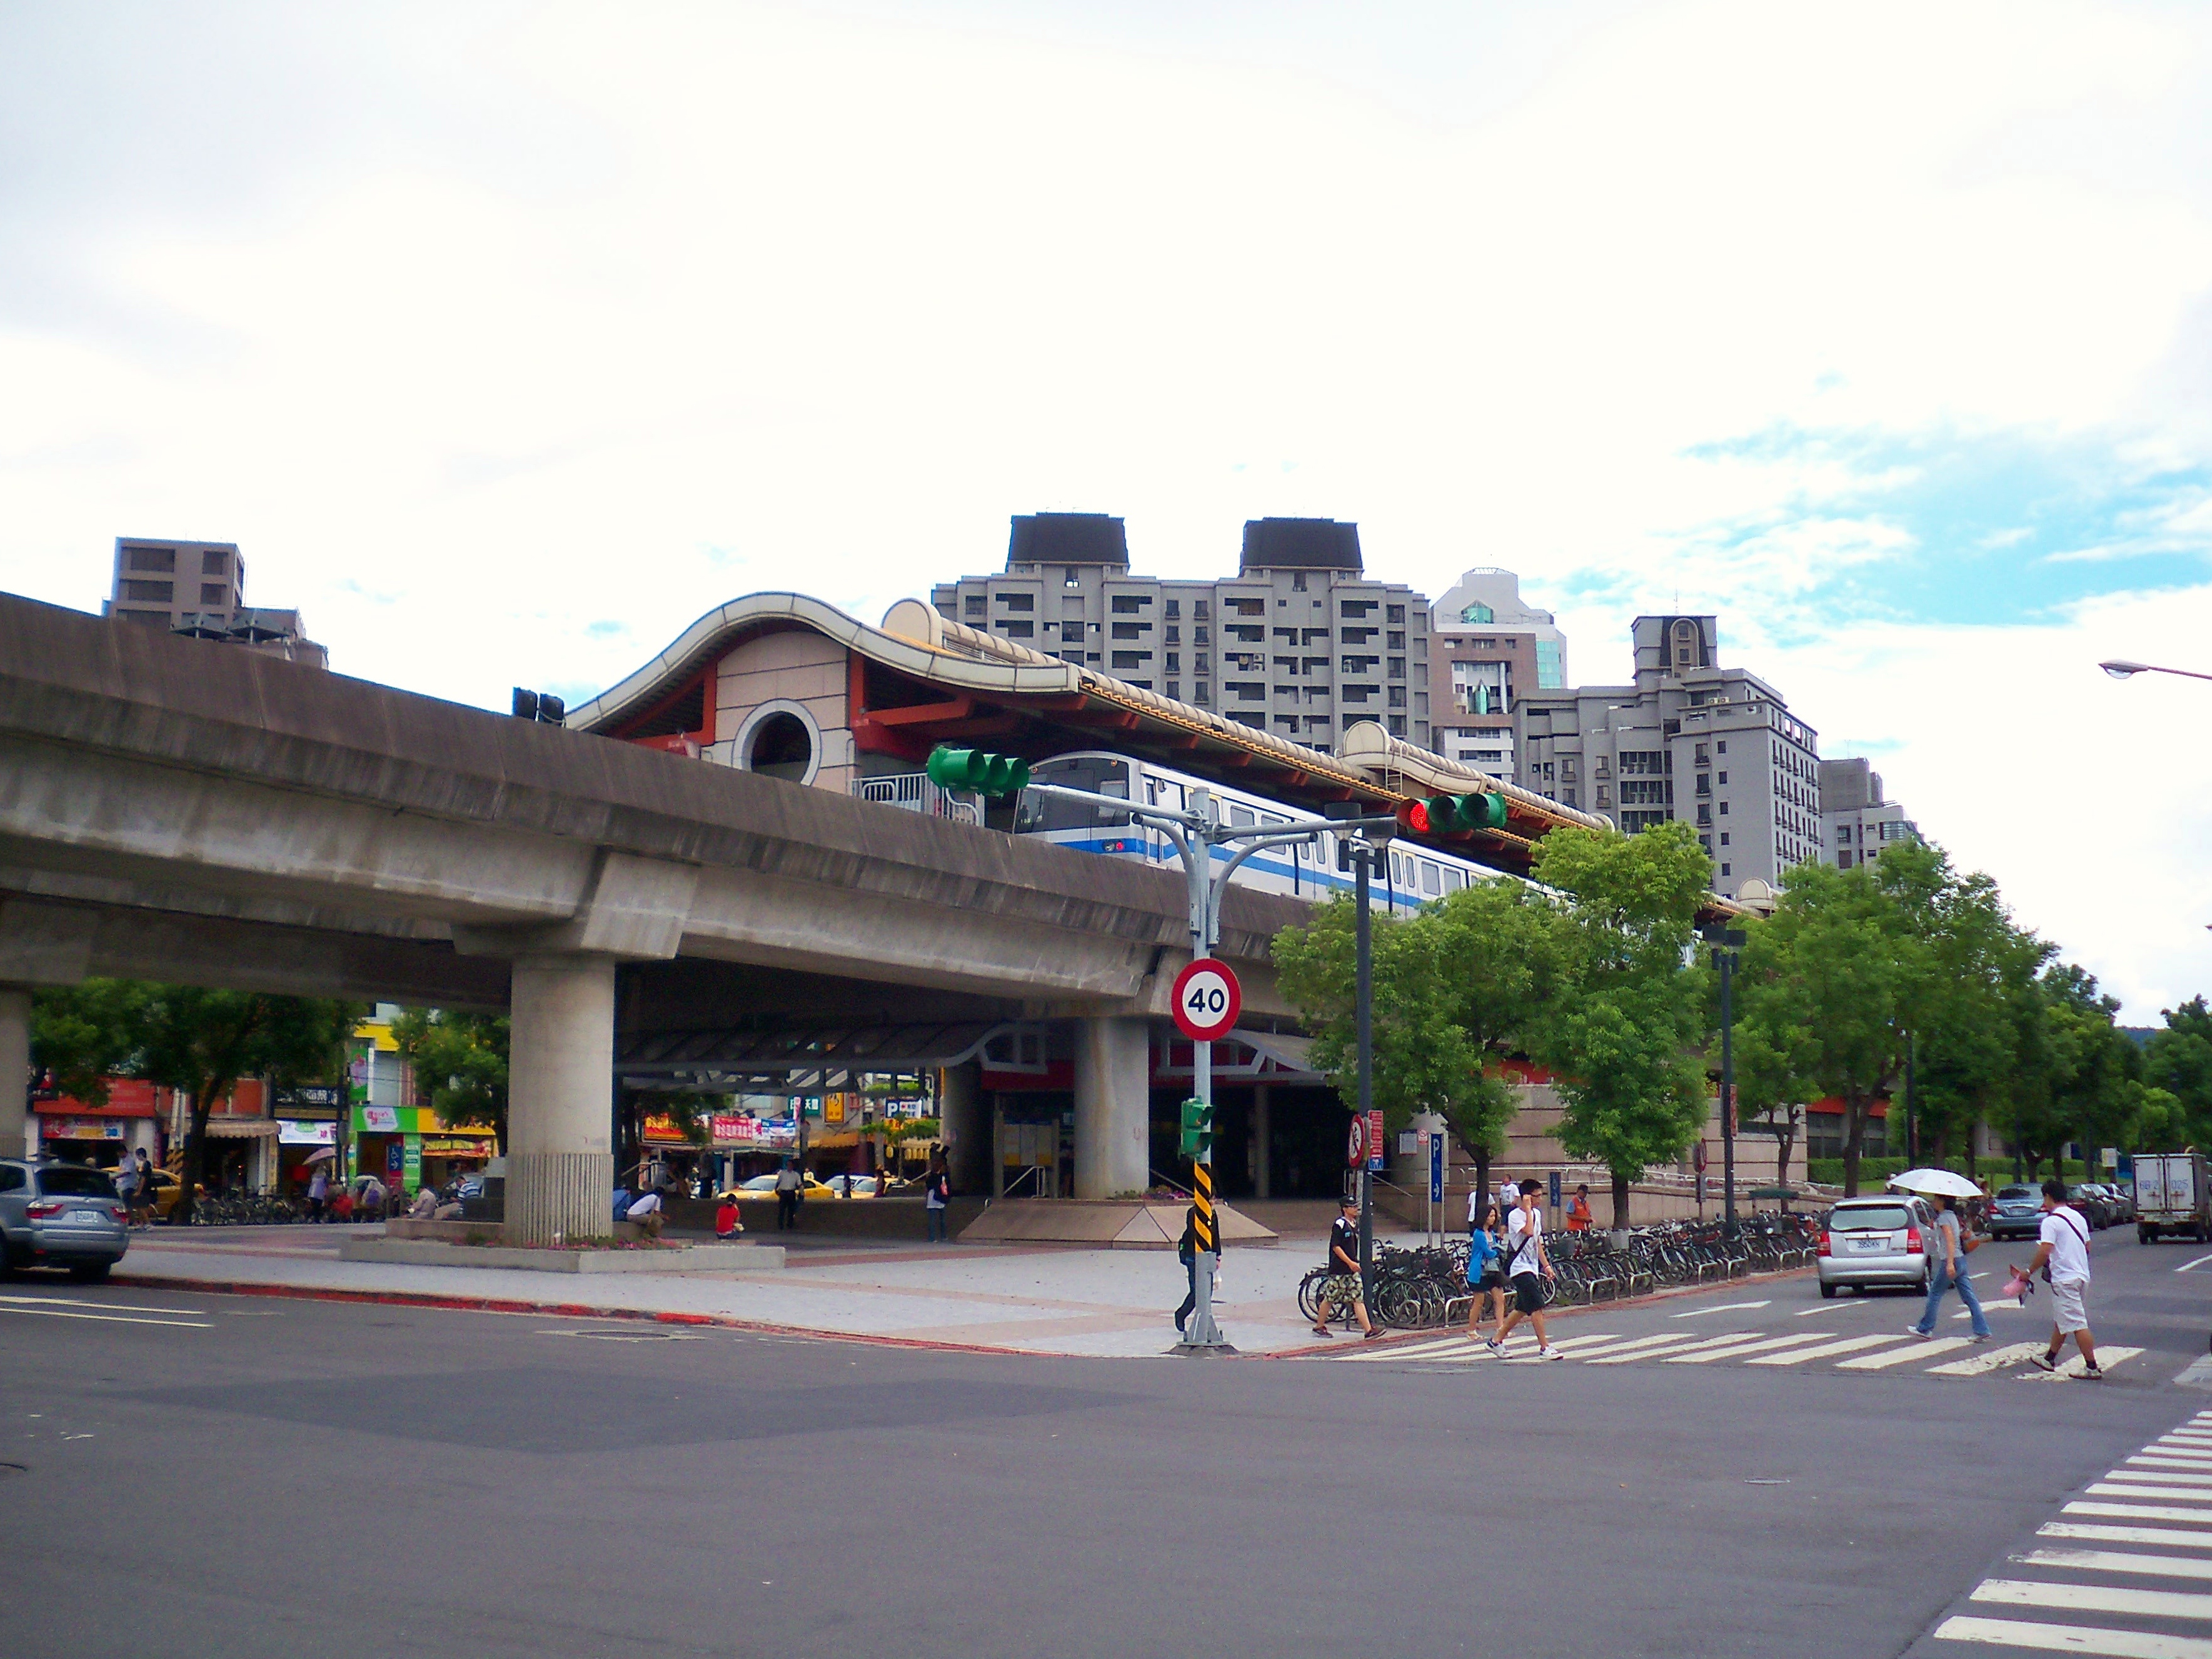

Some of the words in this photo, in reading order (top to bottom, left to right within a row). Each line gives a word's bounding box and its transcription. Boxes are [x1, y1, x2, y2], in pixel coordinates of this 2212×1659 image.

[1188, 988, 1225, 1013] 40
[887, 1102, 898, 1118] P
[1433, 1138, 1440, 1158] P
